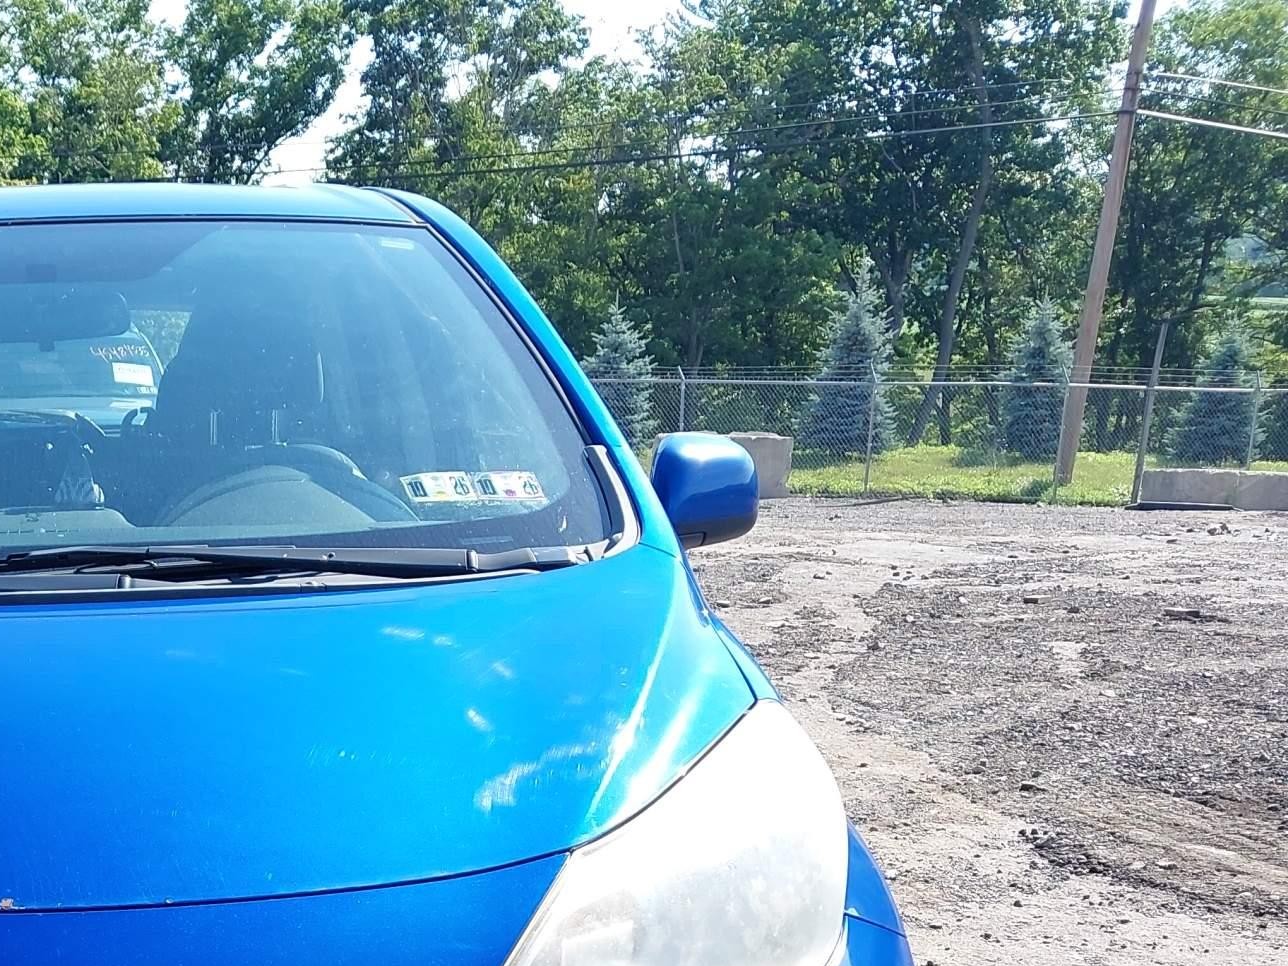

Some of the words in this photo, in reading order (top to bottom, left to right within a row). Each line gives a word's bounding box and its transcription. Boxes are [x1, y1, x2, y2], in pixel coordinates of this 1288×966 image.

[408, 480, 428, 498] 10
[449, 475, 471, 496] 26
[476, 478, 497, 496] 10
